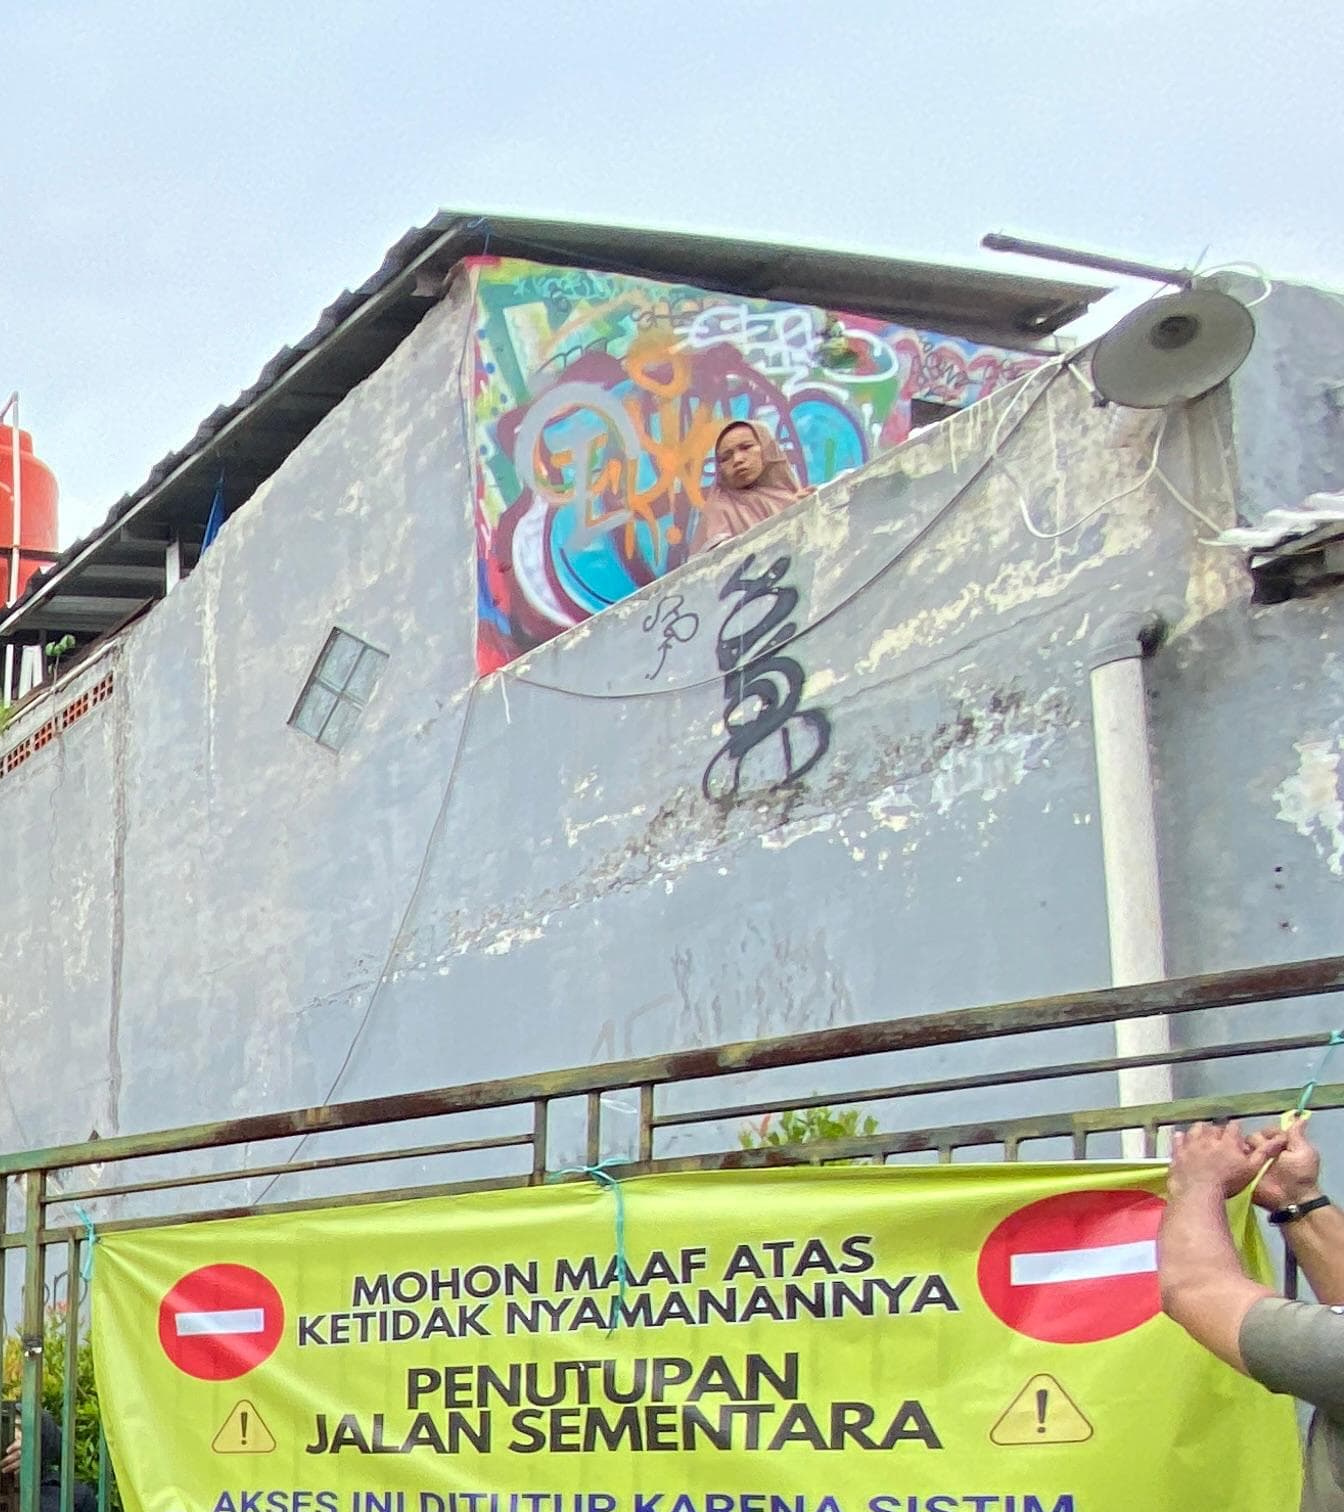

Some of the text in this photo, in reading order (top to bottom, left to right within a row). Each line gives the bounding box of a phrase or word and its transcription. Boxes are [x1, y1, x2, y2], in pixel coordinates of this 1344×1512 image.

[353, 1236, 874, 1307] MOHON MAAF ATAS
[298, 1274, 959, 1346] KETIDAK NYAMANANNYA
[407, 1352, 798, 1410] PENUTUPAN
[305, 1400, 943, 1454] JALAN SEMENTARA
